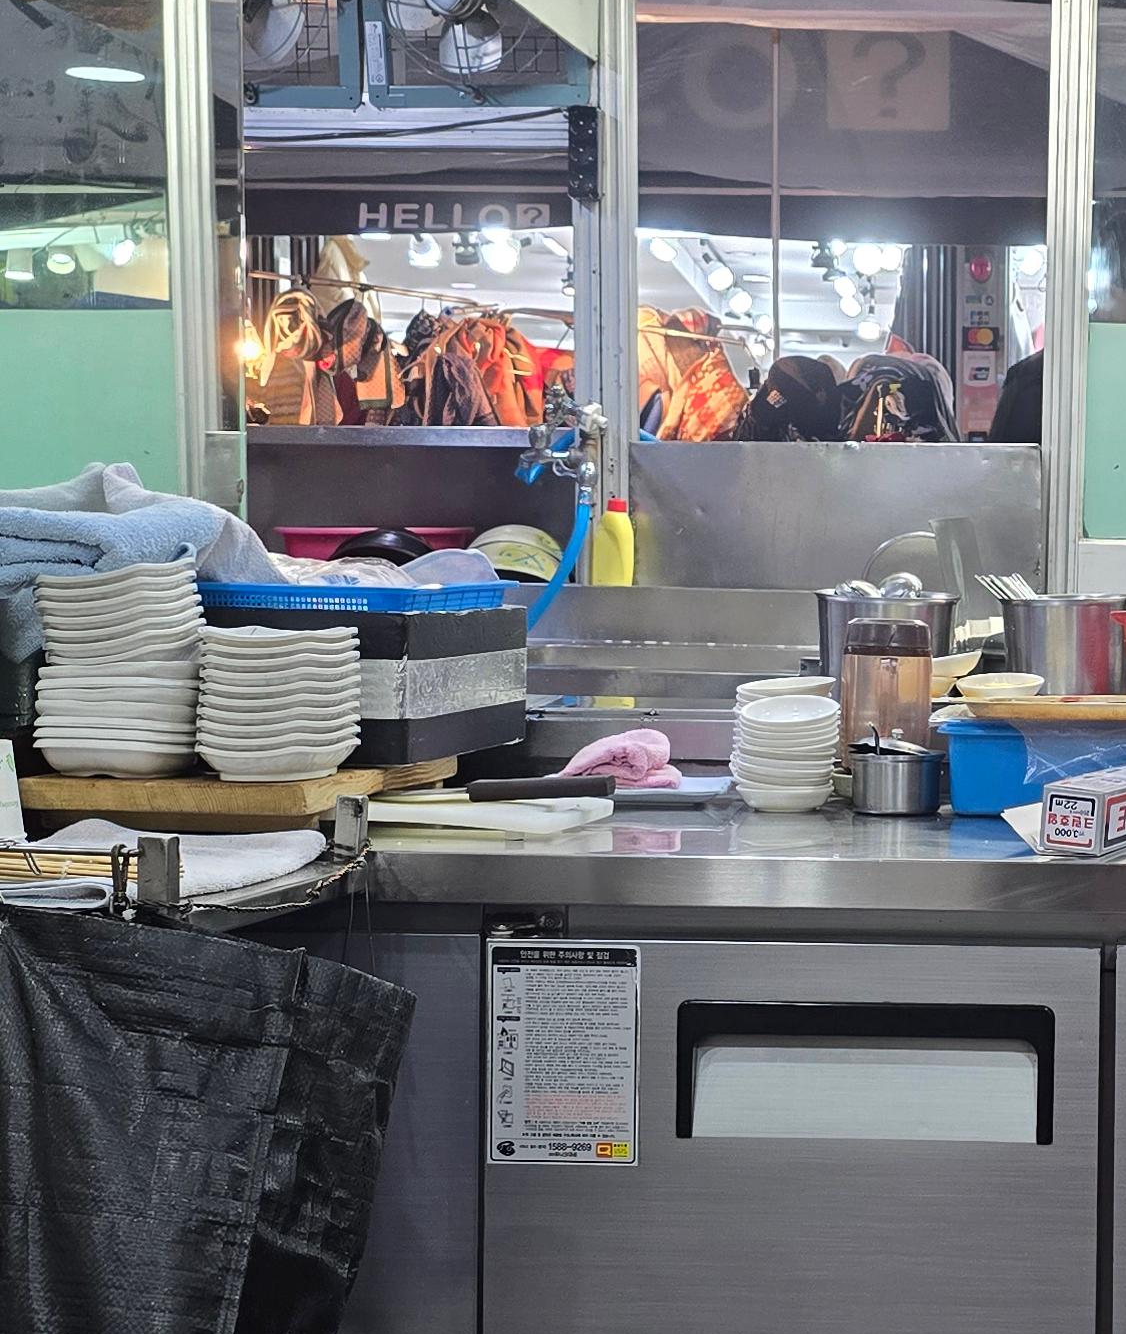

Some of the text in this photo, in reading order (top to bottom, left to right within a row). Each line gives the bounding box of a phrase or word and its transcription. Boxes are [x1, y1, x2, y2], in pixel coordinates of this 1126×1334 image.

[1055, 799, 1078, 810] 22m
[1047, 813, 1095, 829] 크린호일
[558, 950, 585, 959] 주의사항
